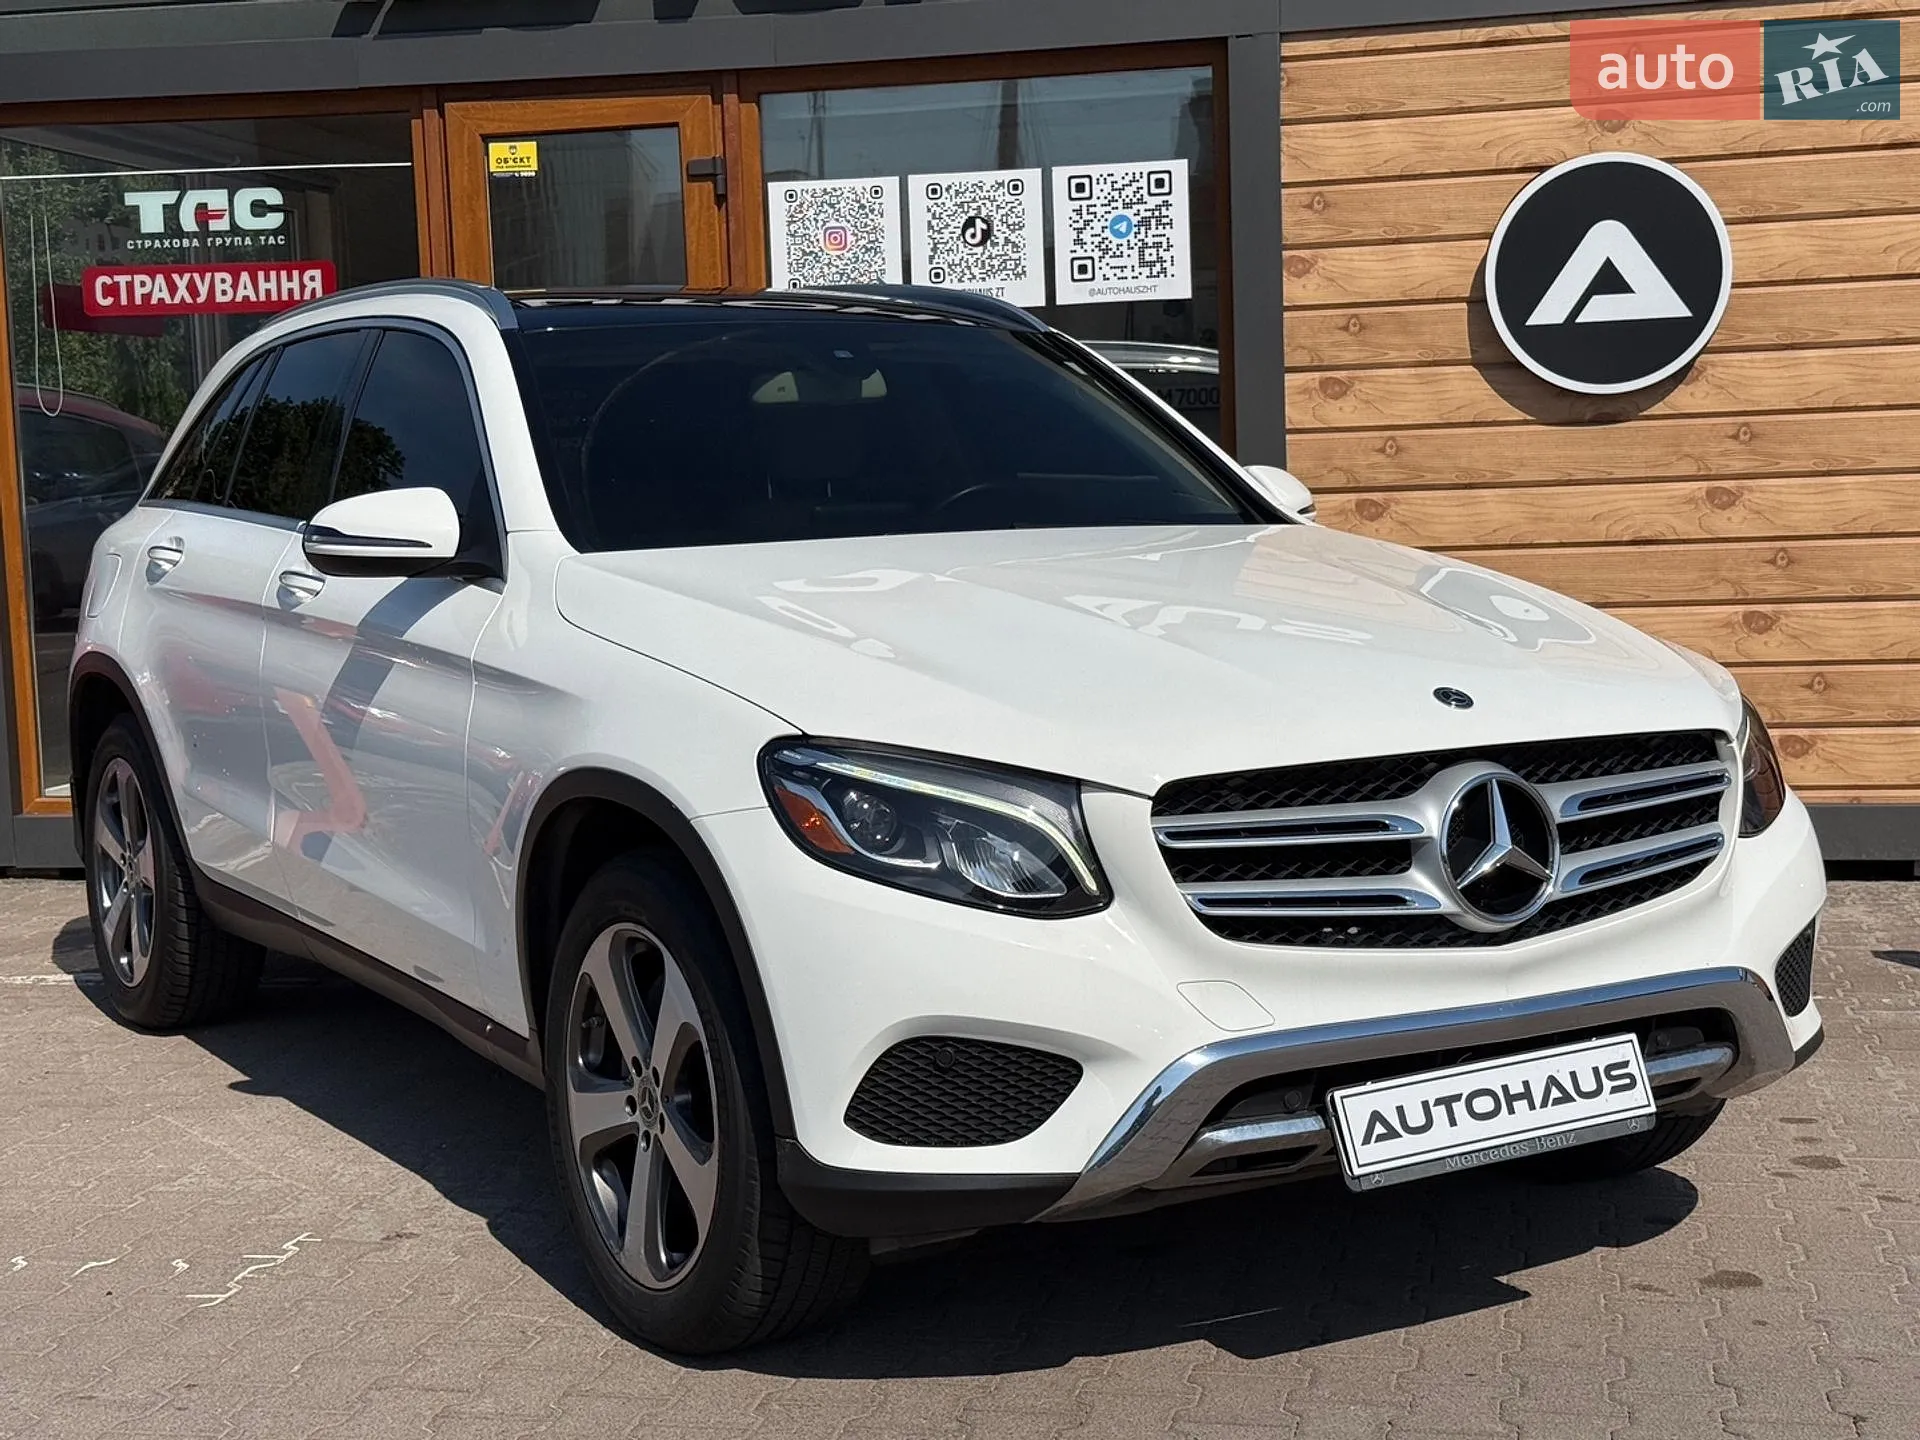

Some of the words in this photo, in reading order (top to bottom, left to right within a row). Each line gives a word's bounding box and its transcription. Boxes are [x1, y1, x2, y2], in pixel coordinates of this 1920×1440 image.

[124, 187, 285, 233] ТАС
[126, 238, 200, 250] СТРАХОВА
[206, 236, 253, 248] ГРУПА
[258, 235, 286, 246] ТАС
[94, 268, 323, 307] СТРАХУВАННЯ
[1088, 285, 1159, 298] @AUTOHAUSZHT
[1360, 1059, 1638, 1147] AUTOHAUS
[1443, 1142, 1529, 1171] Mercedes
[1535, 1131, 1578, 1153] Benz
